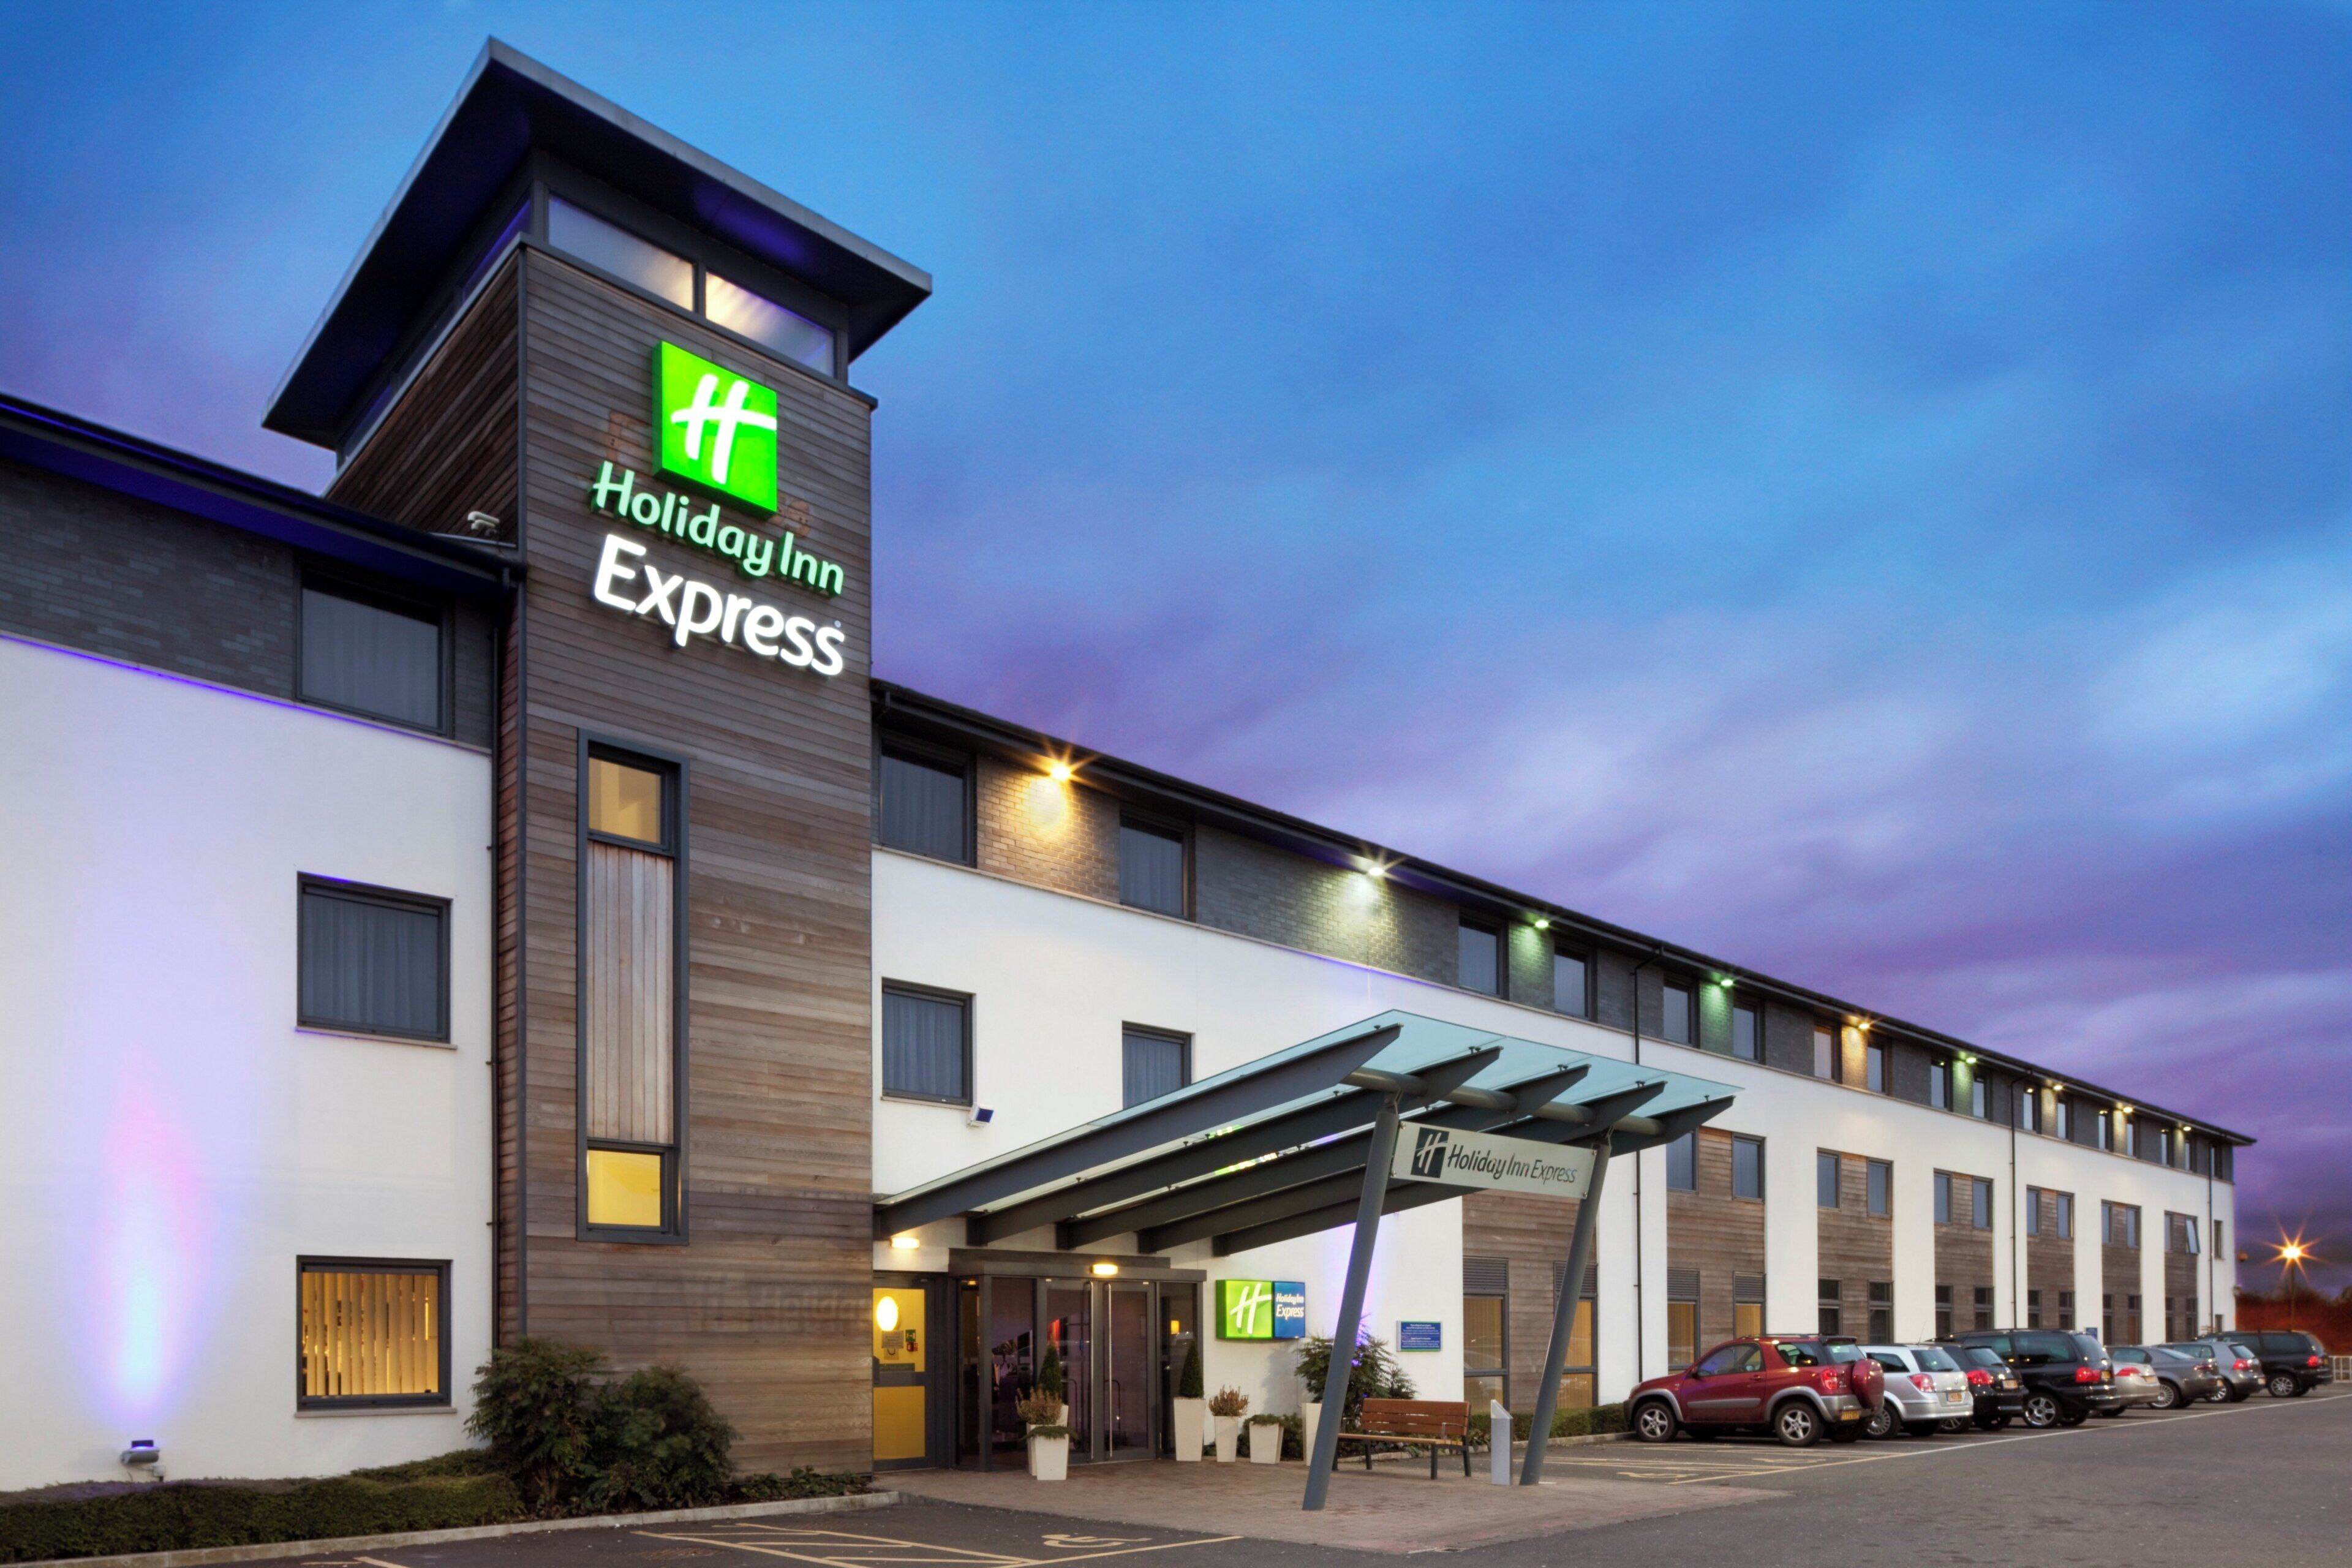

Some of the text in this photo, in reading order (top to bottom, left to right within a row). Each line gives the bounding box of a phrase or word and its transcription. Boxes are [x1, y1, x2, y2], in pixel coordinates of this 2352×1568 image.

[671, 373, 777, 484] H
[592, 460, 845, 595] Holiday Inn
[593, 533, 845, 676] Express
[1447, 1144, 1578, 1185] Holiday Inn Express
[1230, 1283, 1272, 1335] H
[1275, 1292, 1296, 1305] Holiday
[1276, 1303, 1305, 1321] Express
